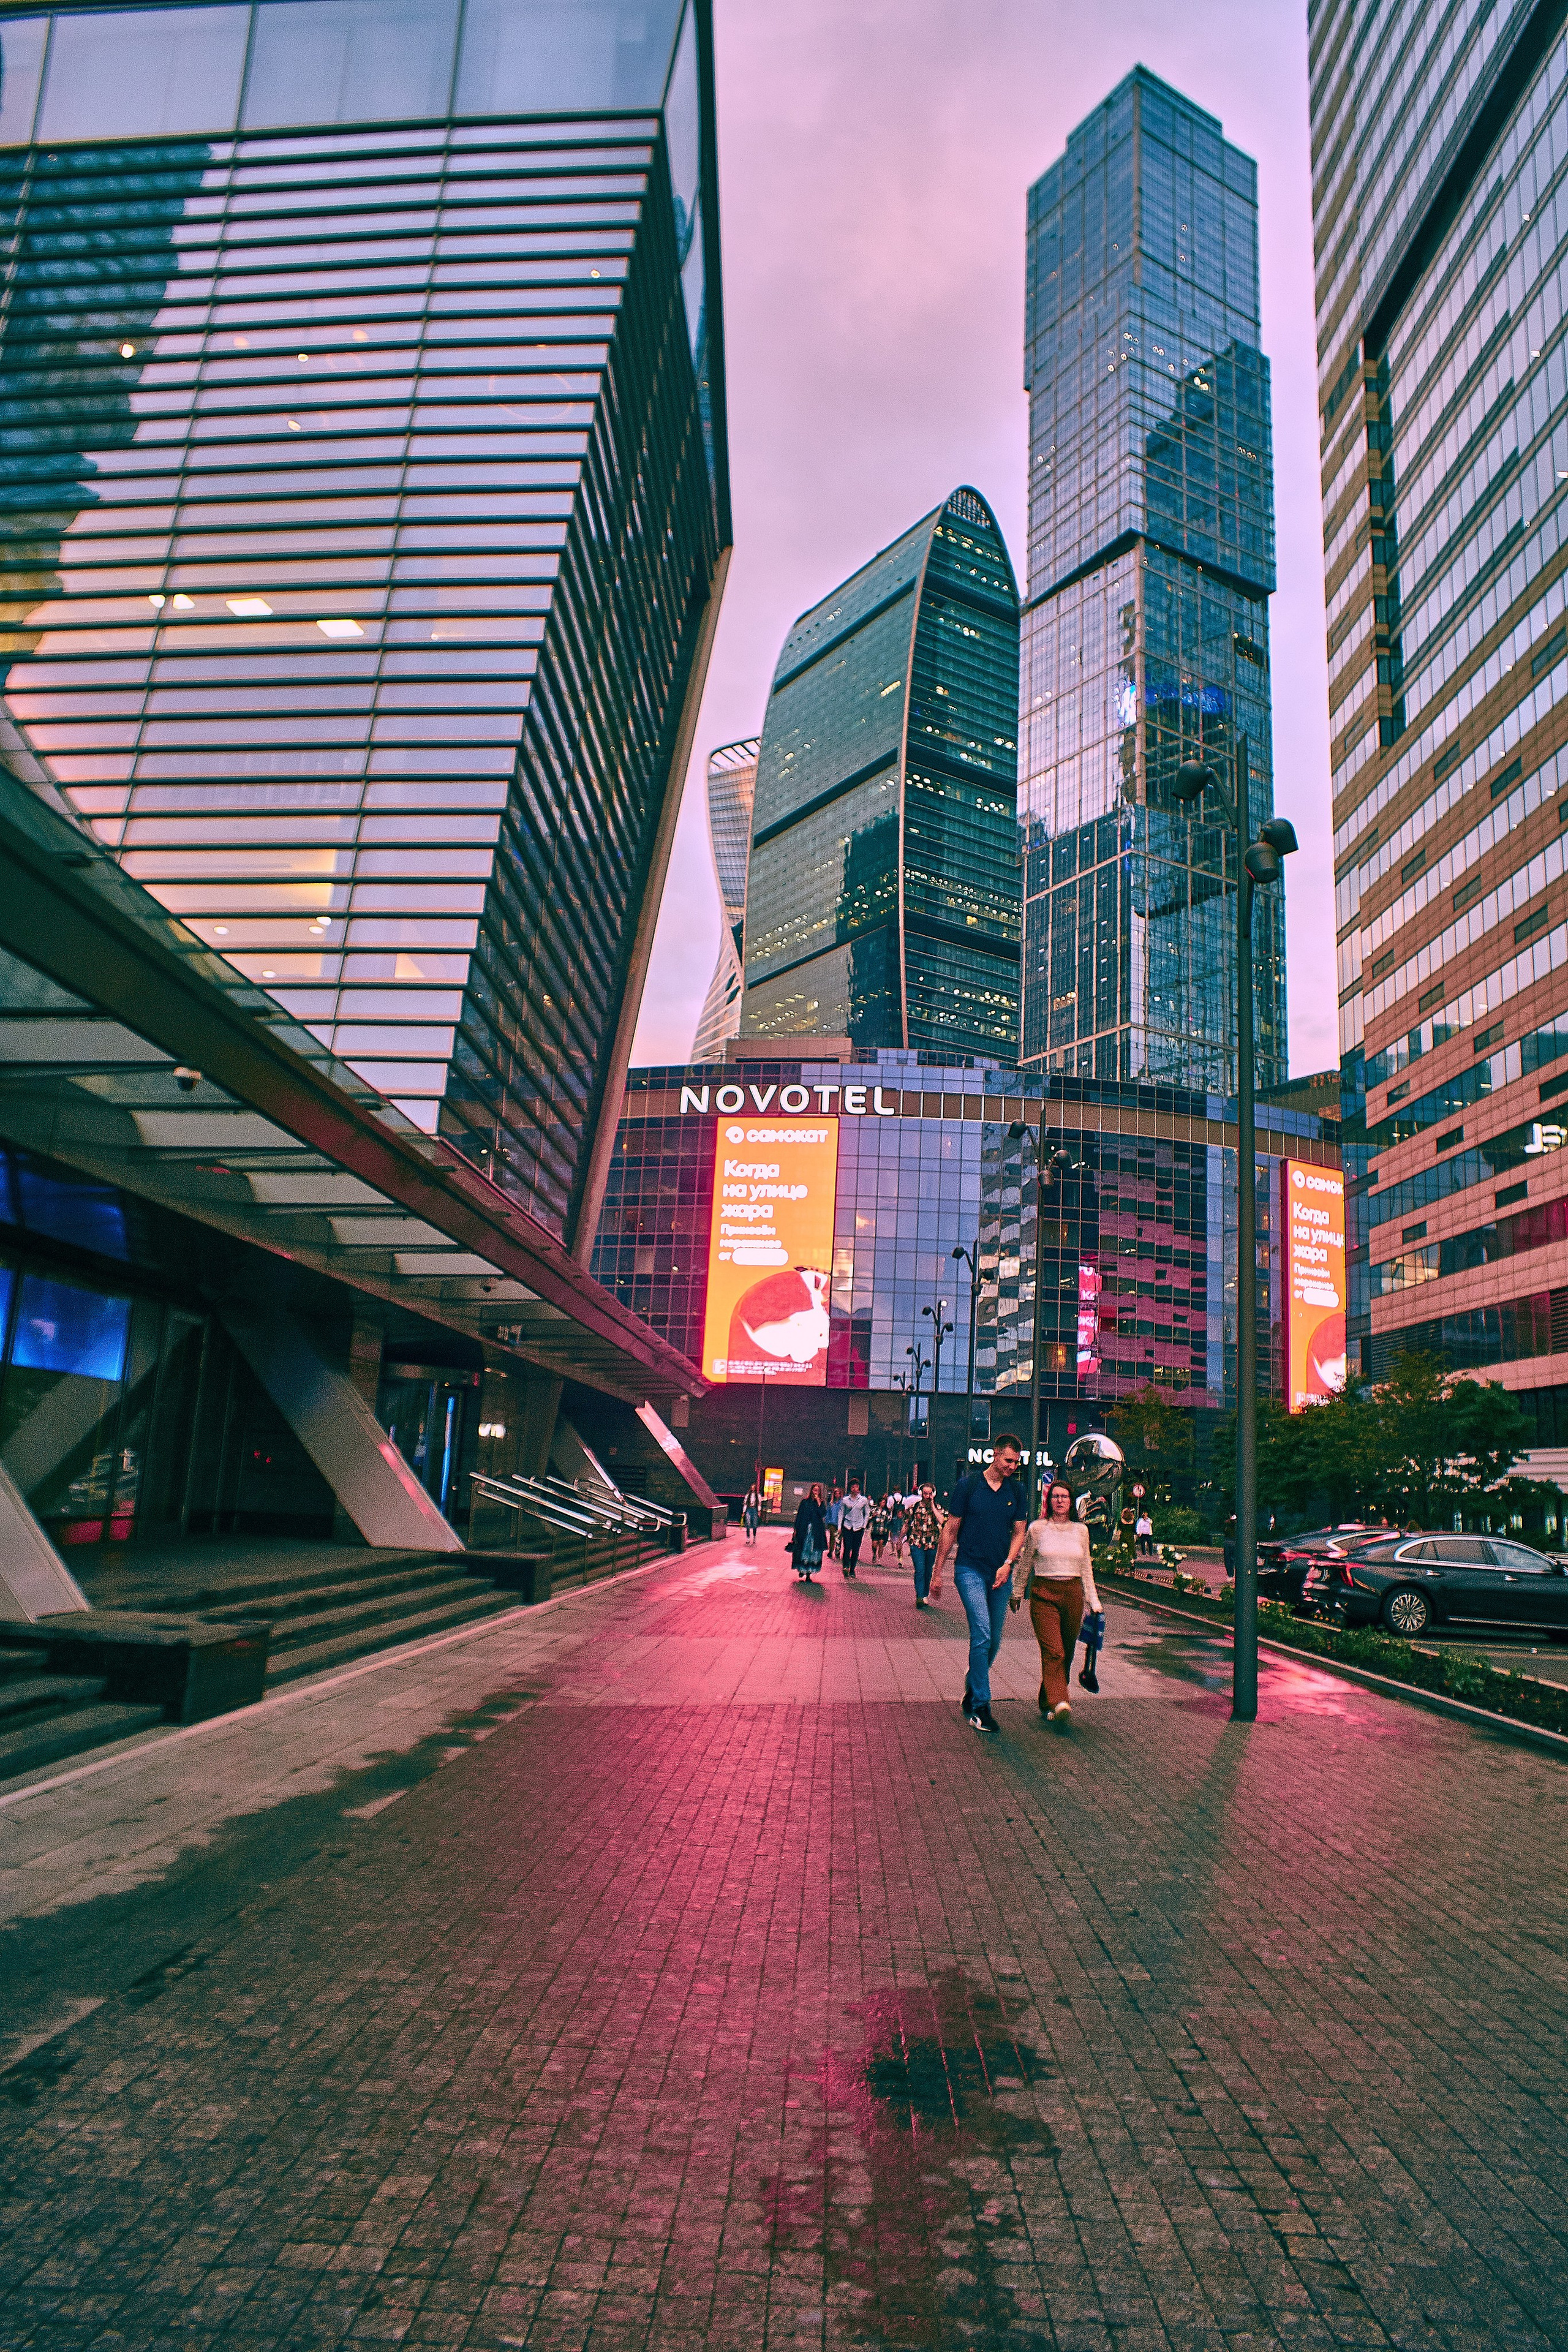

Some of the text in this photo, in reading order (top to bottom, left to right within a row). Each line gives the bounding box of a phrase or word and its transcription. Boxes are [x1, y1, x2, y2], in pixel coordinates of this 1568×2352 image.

[679, 1084, 895, 1115] NOVOTEL
[746, 1129, 829, 1143] самокат
[724, 1159, 780, 1180] Когда
[723, 1183, 808, 1202] на улице
[720, 1204, 774, 1222] жара
[1293, 1201, 1330, 1225] Когда
[1293, 1224, 1310, 1240] на
[1293, 1244, 1328, 1265] жара
[968, 1448, 1054, 1467] NOTEL
